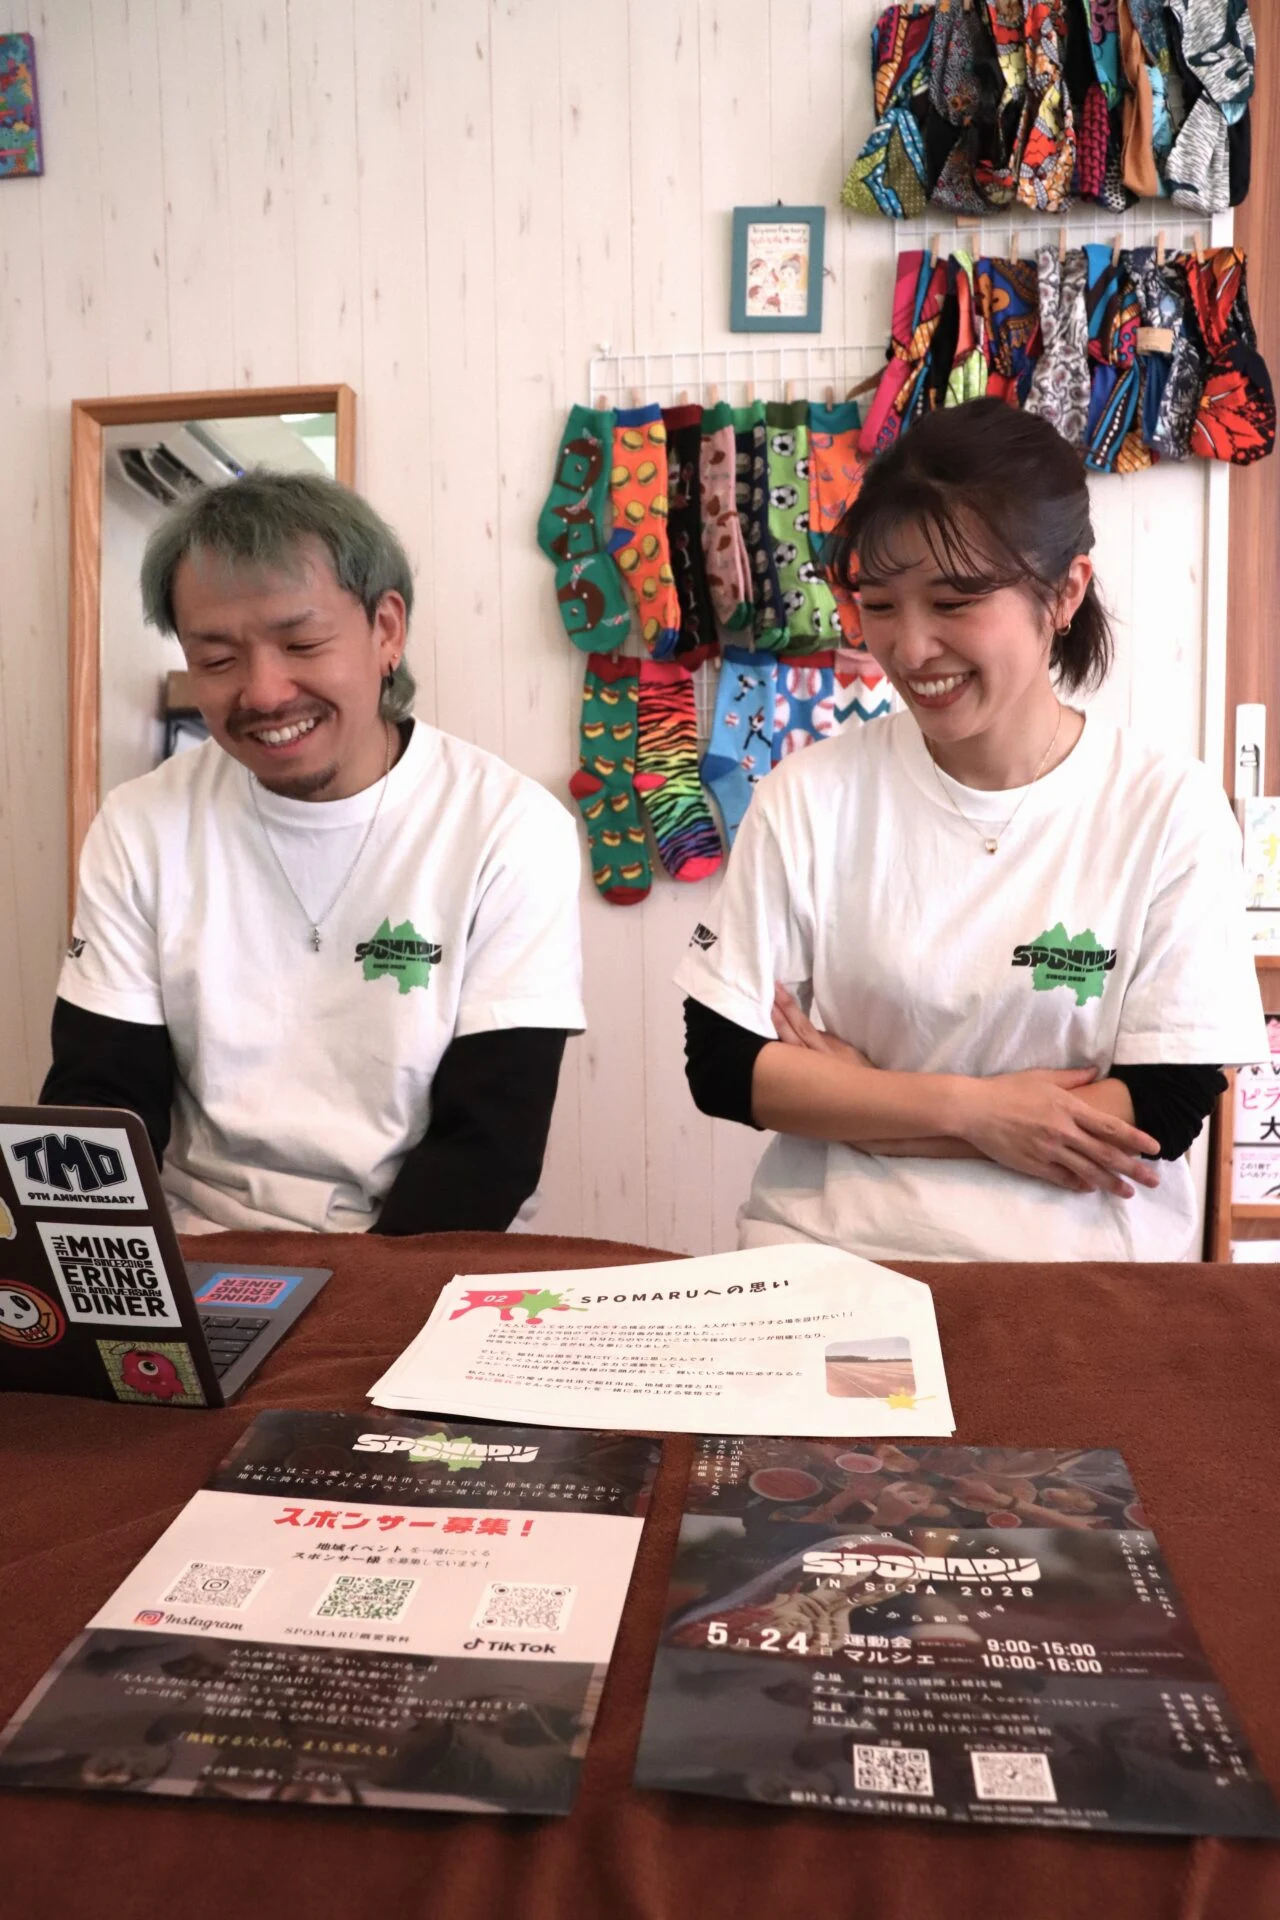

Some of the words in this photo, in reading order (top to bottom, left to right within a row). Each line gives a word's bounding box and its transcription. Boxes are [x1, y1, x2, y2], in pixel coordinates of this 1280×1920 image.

[1012, 945, 1117, 973] SPOMARU
[1260, 1116, 1280, 1140] 大
[28, 1192, 50, 1201] 9TH
[53, 1193, 136, 1204] ANNIVERSARY
[51, 1235, 69, 1256] THE
[66, 1235, 150, 1260] MING
[61, 1265, 159, 1289] ERING
[71, 1294, 169, 1317] DINER
[482, 1294, 509, 1303] 02
[352, 1433, 541, 1463] SPOMARU
[274, 1507, 535, 1537] スポンサー募集！
[803, 1551, 1041, 1581] SPOMARU
[816, 1577, 841, 1589] IN
[864, 1582, 937, 1595] SOJA
[961, 1586, 1034, 1597] 2026
[164, 1611, 243, 1632] Instagram
[487, 1638, 557, 1655] TikTok
[843, 1633, 911, 1649] 運動会
[844, 1649, 935, 1665] マルシェ
[981, 1654, 1102, 1673] 10:00-16:00
